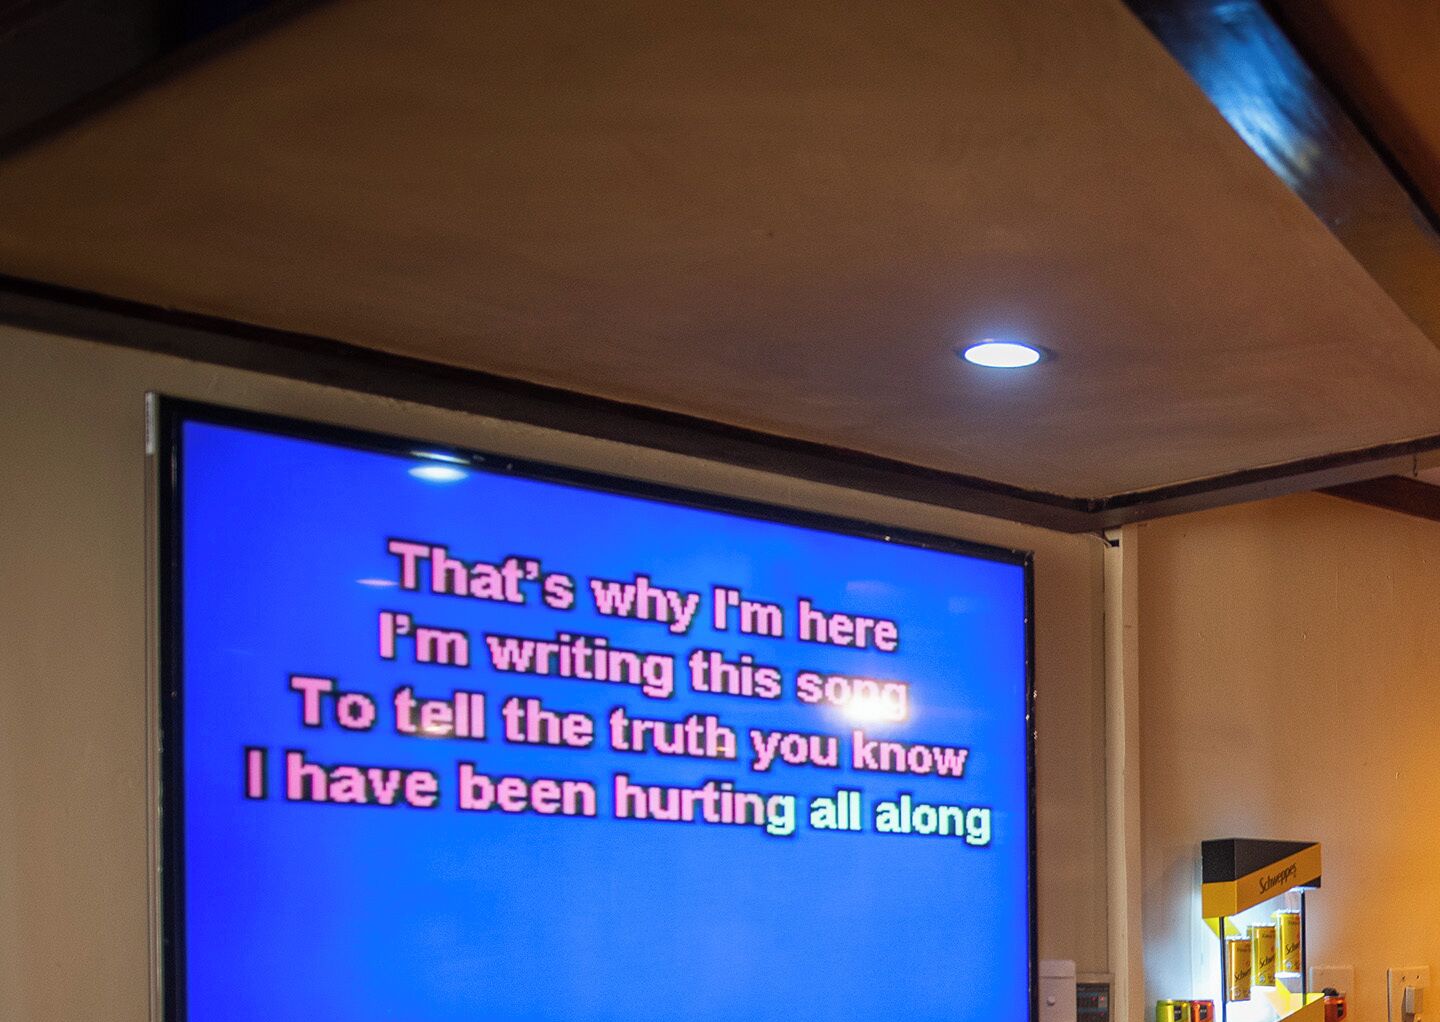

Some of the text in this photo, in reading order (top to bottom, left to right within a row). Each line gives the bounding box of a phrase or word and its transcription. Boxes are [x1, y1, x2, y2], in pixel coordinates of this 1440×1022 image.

[388, 540, 899, 651] That's why I'm here
[379, 612, 909, 721] I'm writing this song
[291, 676, 969, 777] To tell the truth you know
[246, 750, 991, 846] I have been hurting all along
[1259, 863, 1297, 895] Schweppes
